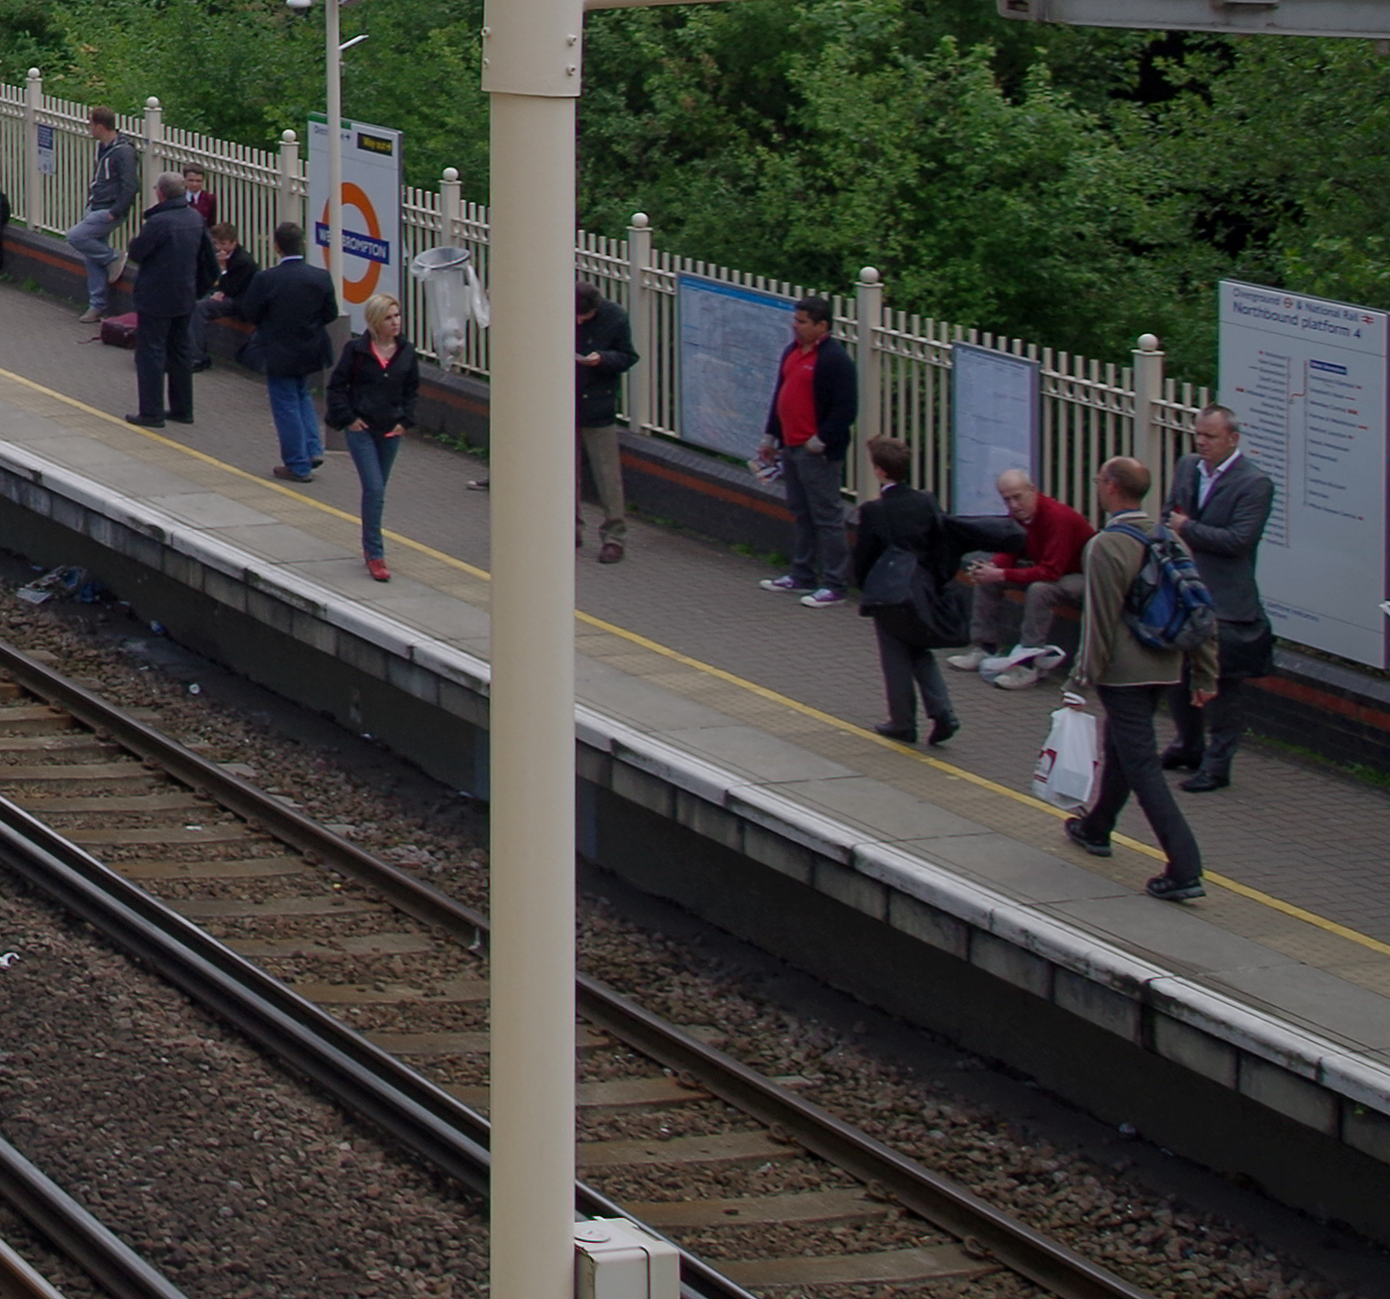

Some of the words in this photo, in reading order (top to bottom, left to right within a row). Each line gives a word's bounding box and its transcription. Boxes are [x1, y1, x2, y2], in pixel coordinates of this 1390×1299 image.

[1232, 288, 1280, 306] Overground
[1305, 303, 1340, 318] National
[1343, 310, 1359, 322] Rail
[1233, 301, 1298, 326] Northbound
[1301, 316, 1350, 337] platform
[1353, 328, 1361, 338] 4
